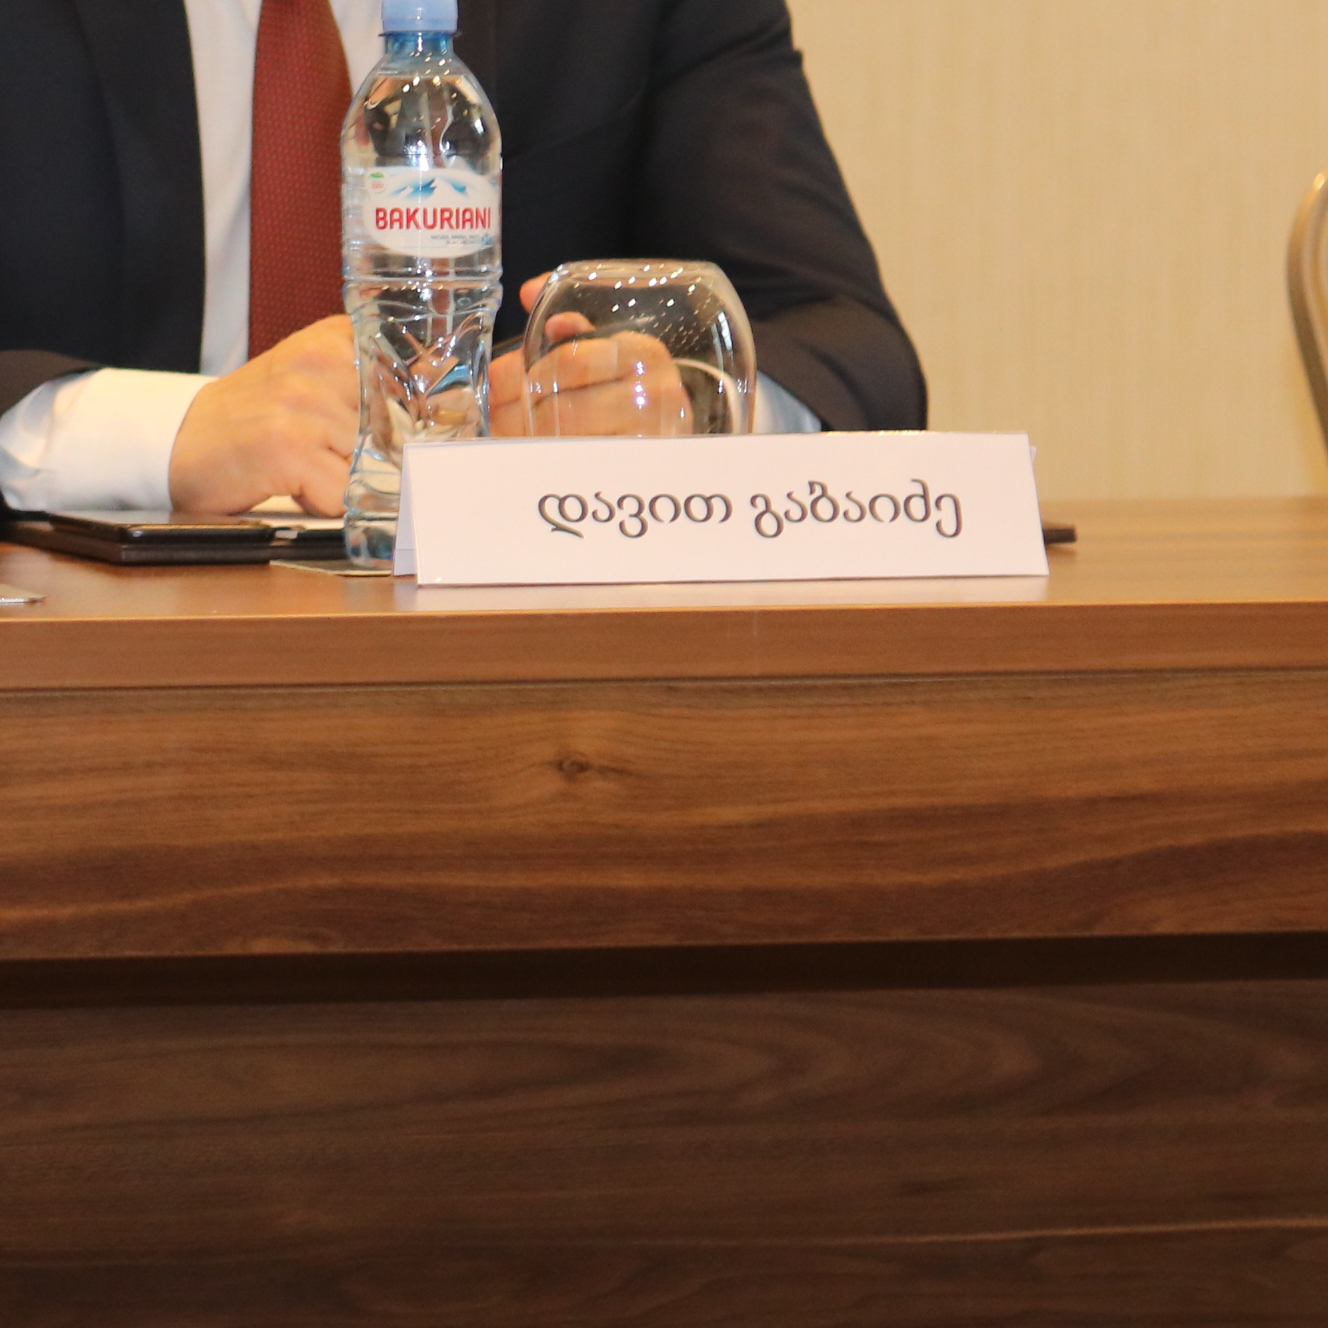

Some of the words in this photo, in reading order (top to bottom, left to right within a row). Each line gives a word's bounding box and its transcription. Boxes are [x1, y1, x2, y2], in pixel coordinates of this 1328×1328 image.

[375, 207, 492, 231] BAKURIANI
[538, 491, 733, 539] დავით
[749, 479, 963, 539] გაბაიძე
